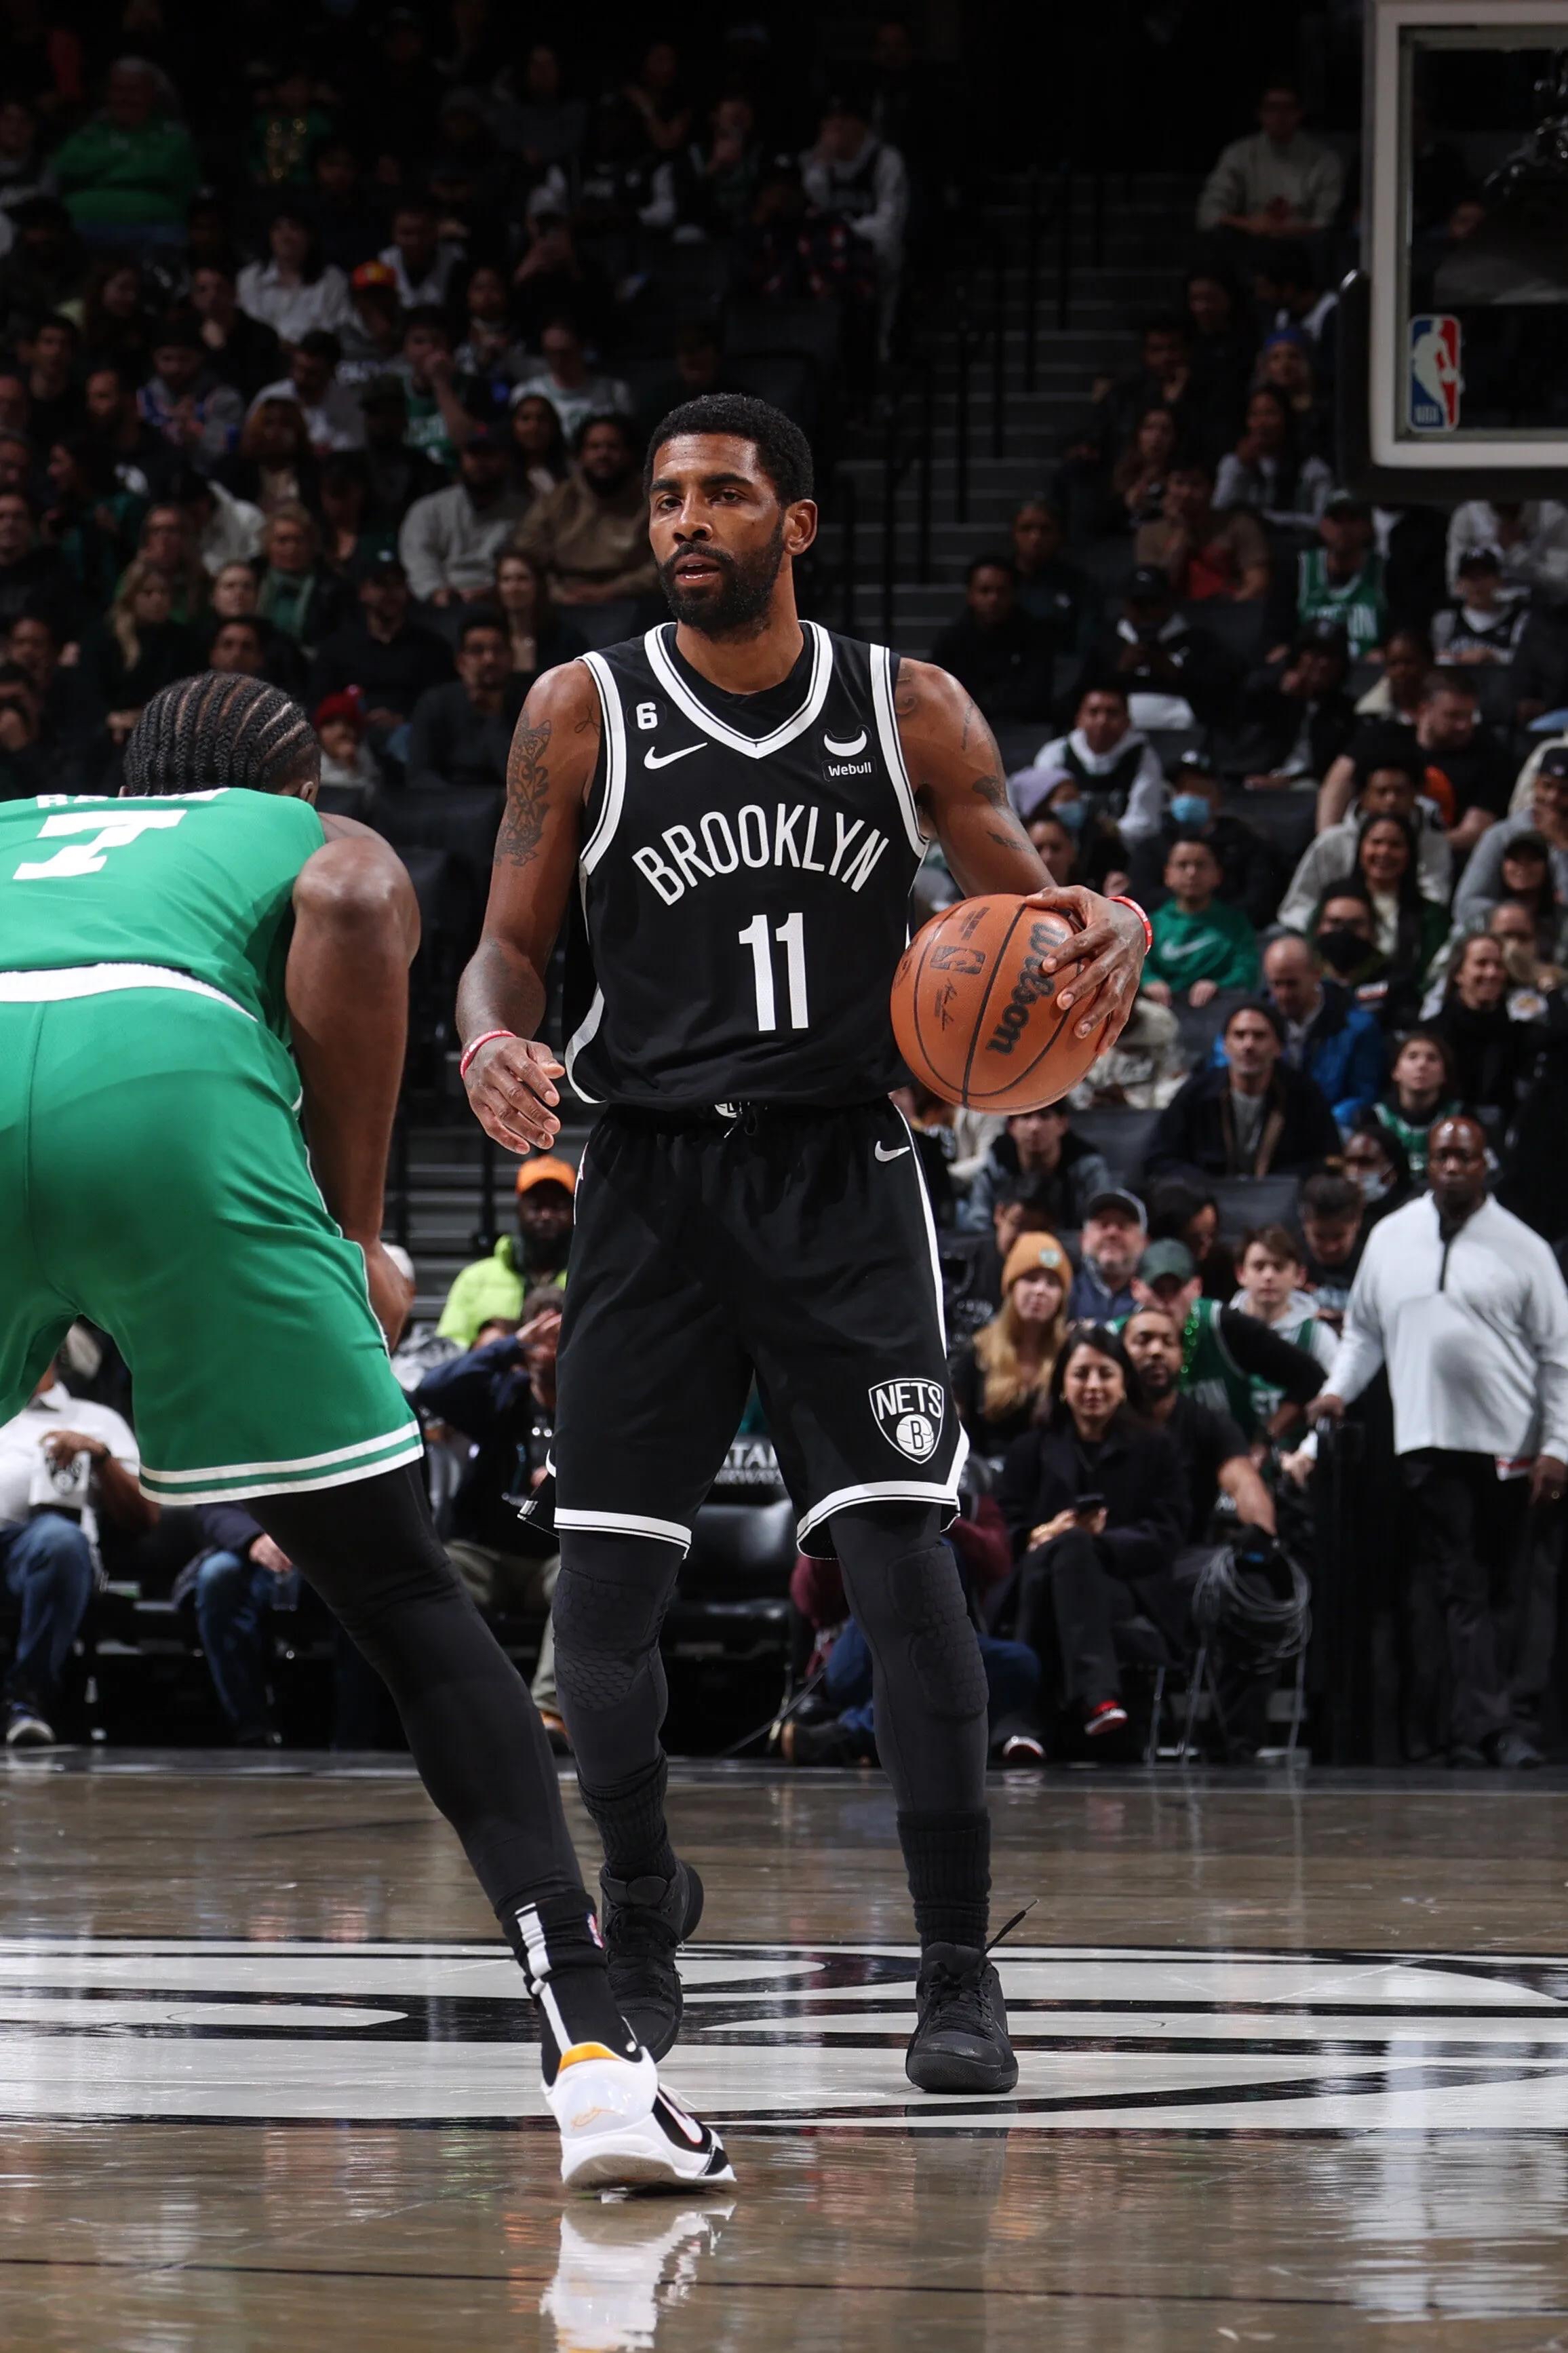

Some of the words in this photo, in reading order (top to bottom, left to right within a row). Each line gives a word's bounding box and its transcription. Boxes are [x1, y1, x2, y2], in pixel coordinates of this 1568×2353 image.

[636, 702, 658, 730] 6
[828, 762, 871, 777] Webull
[12, 810, 187, 880] 7
[631, 803, 890, 906] BROOKLYN
[739, 912, 809, 1031] 11
[876, 1382, 942, 1420] NETS
[910, 1420, 924, 1450] B
